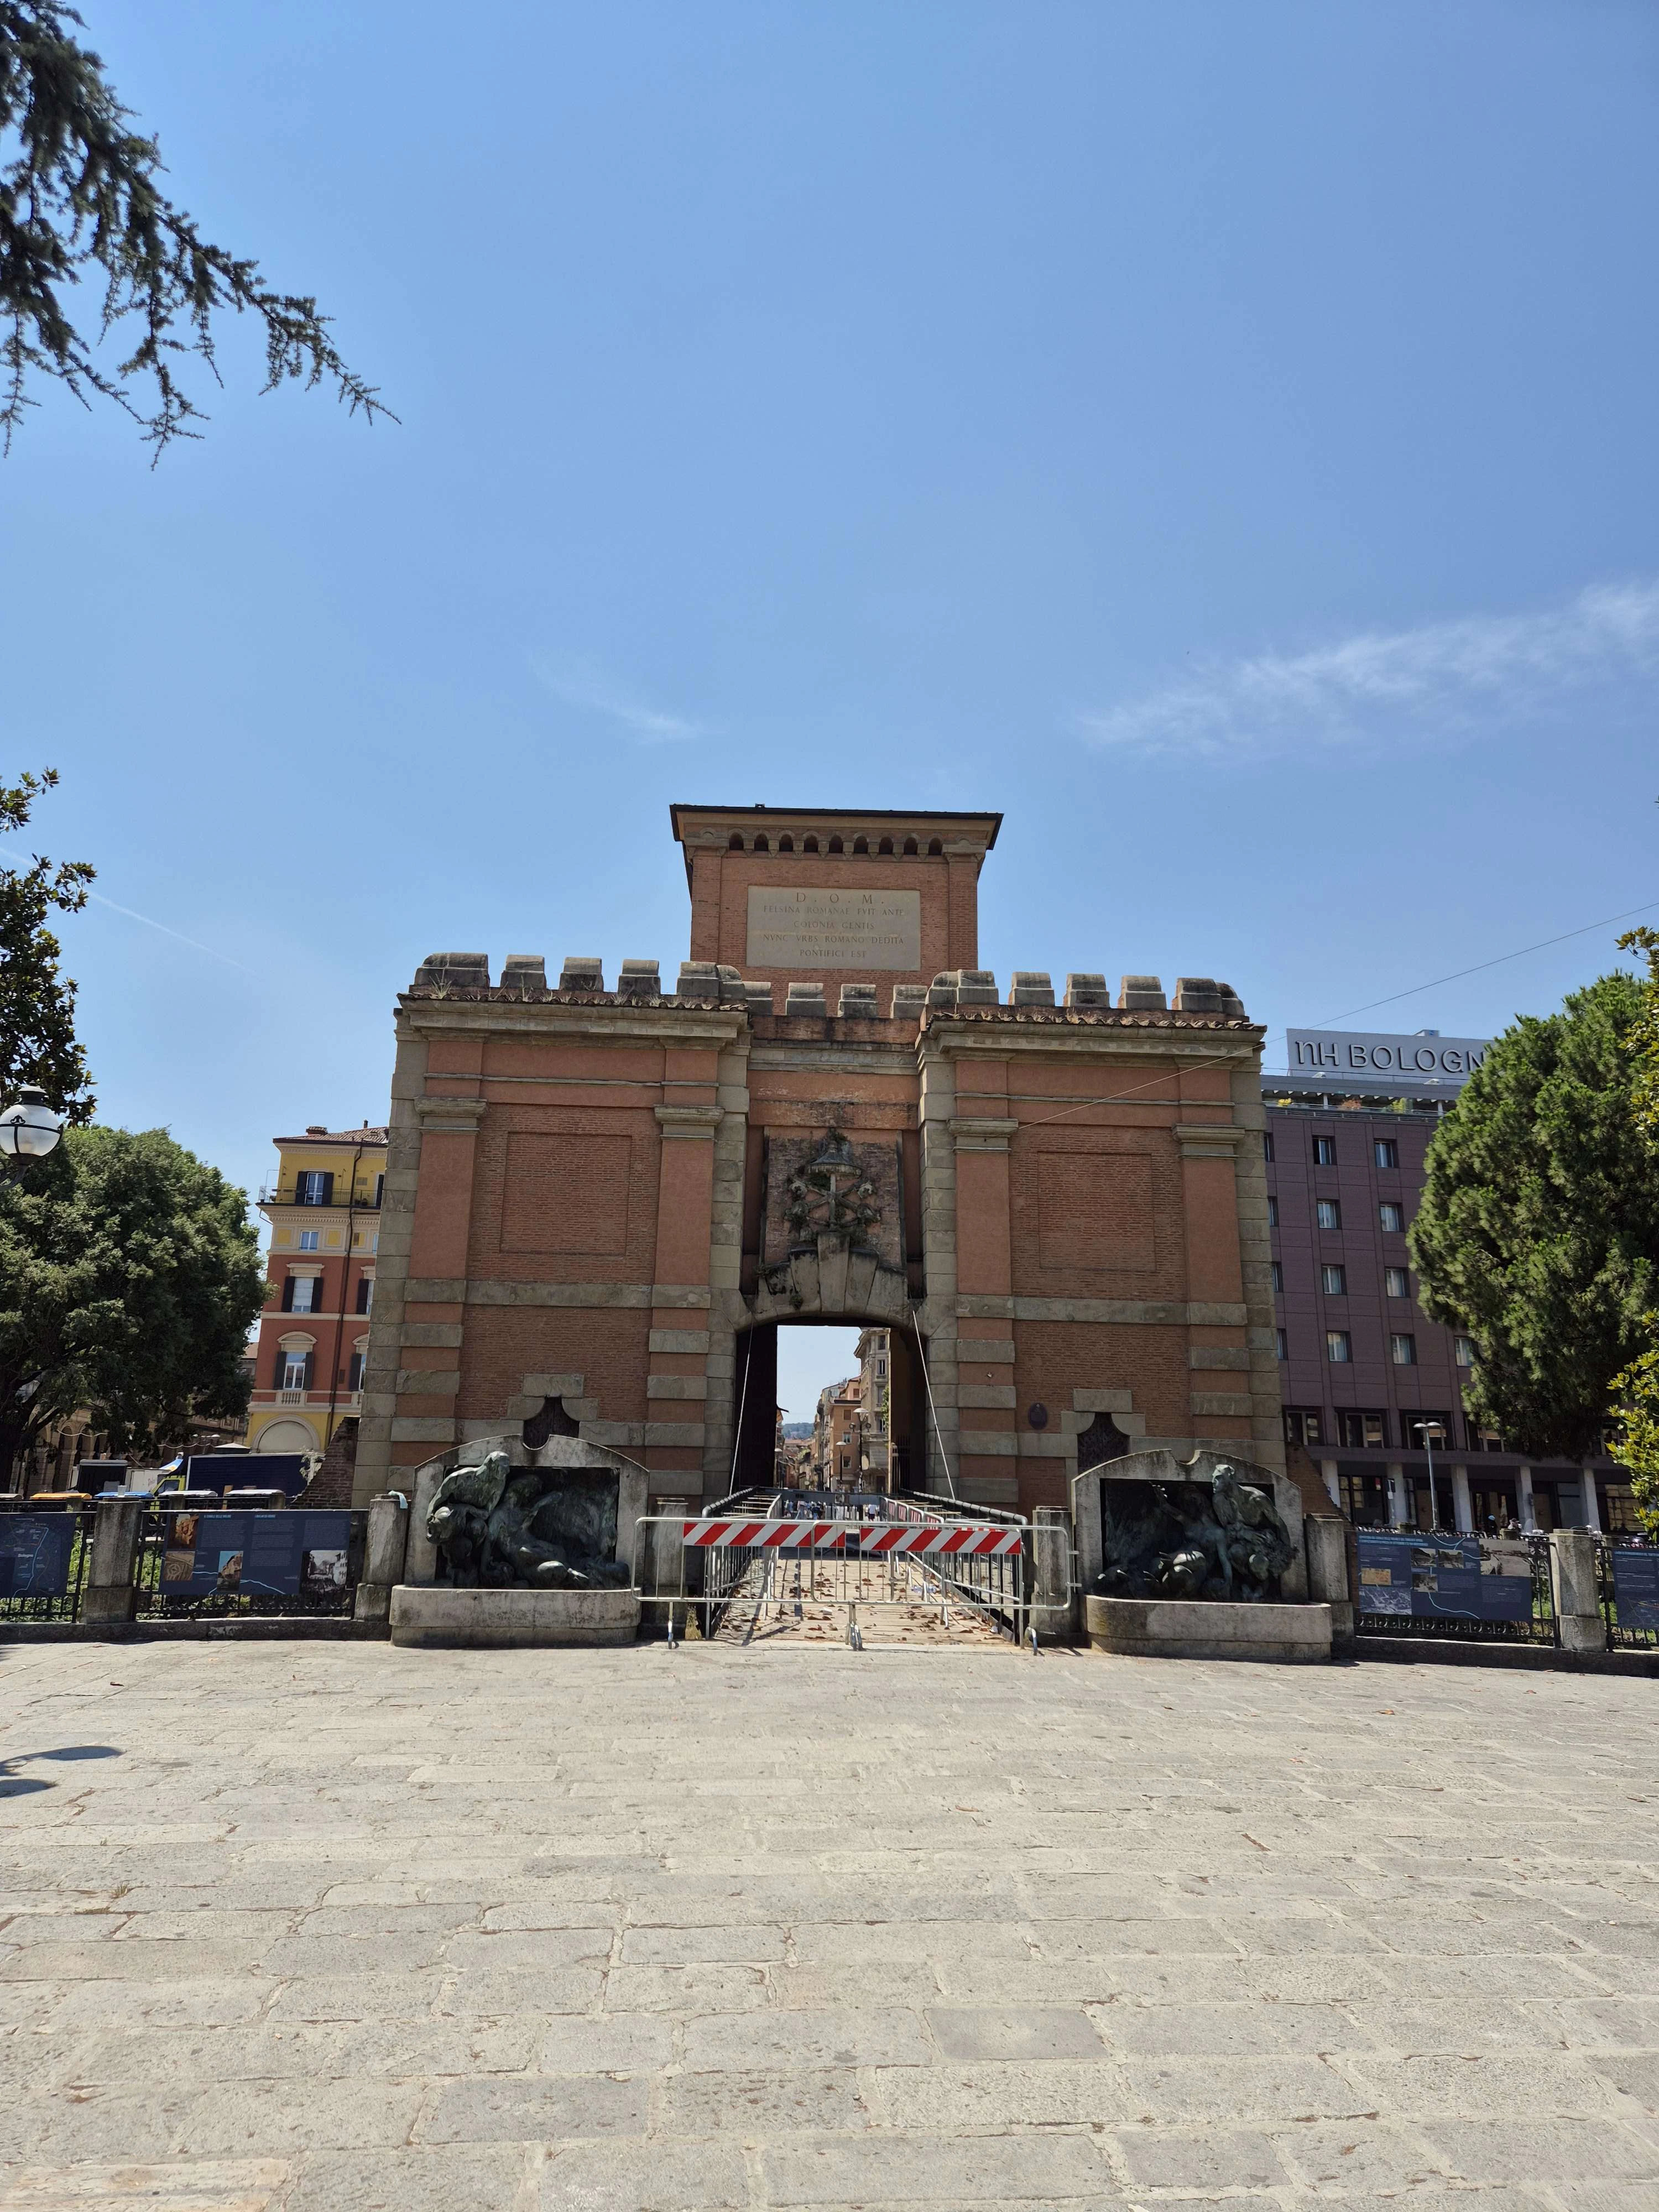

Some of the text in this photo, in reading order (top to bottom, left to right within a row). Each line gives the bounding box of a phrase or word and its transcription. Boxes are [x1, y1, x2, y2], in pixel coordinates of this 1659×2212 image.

[763, 905, 800, 913] FELSINA
[807, 906, 849, 915] ROMANAE
[794, 920, 834, 928] COLONIA
[825, 935, 865, 943] ROMANO
[800, 949, 844, 957] PONTIFICI
[1349, 1044, 1487, 1073] BOLOGN
